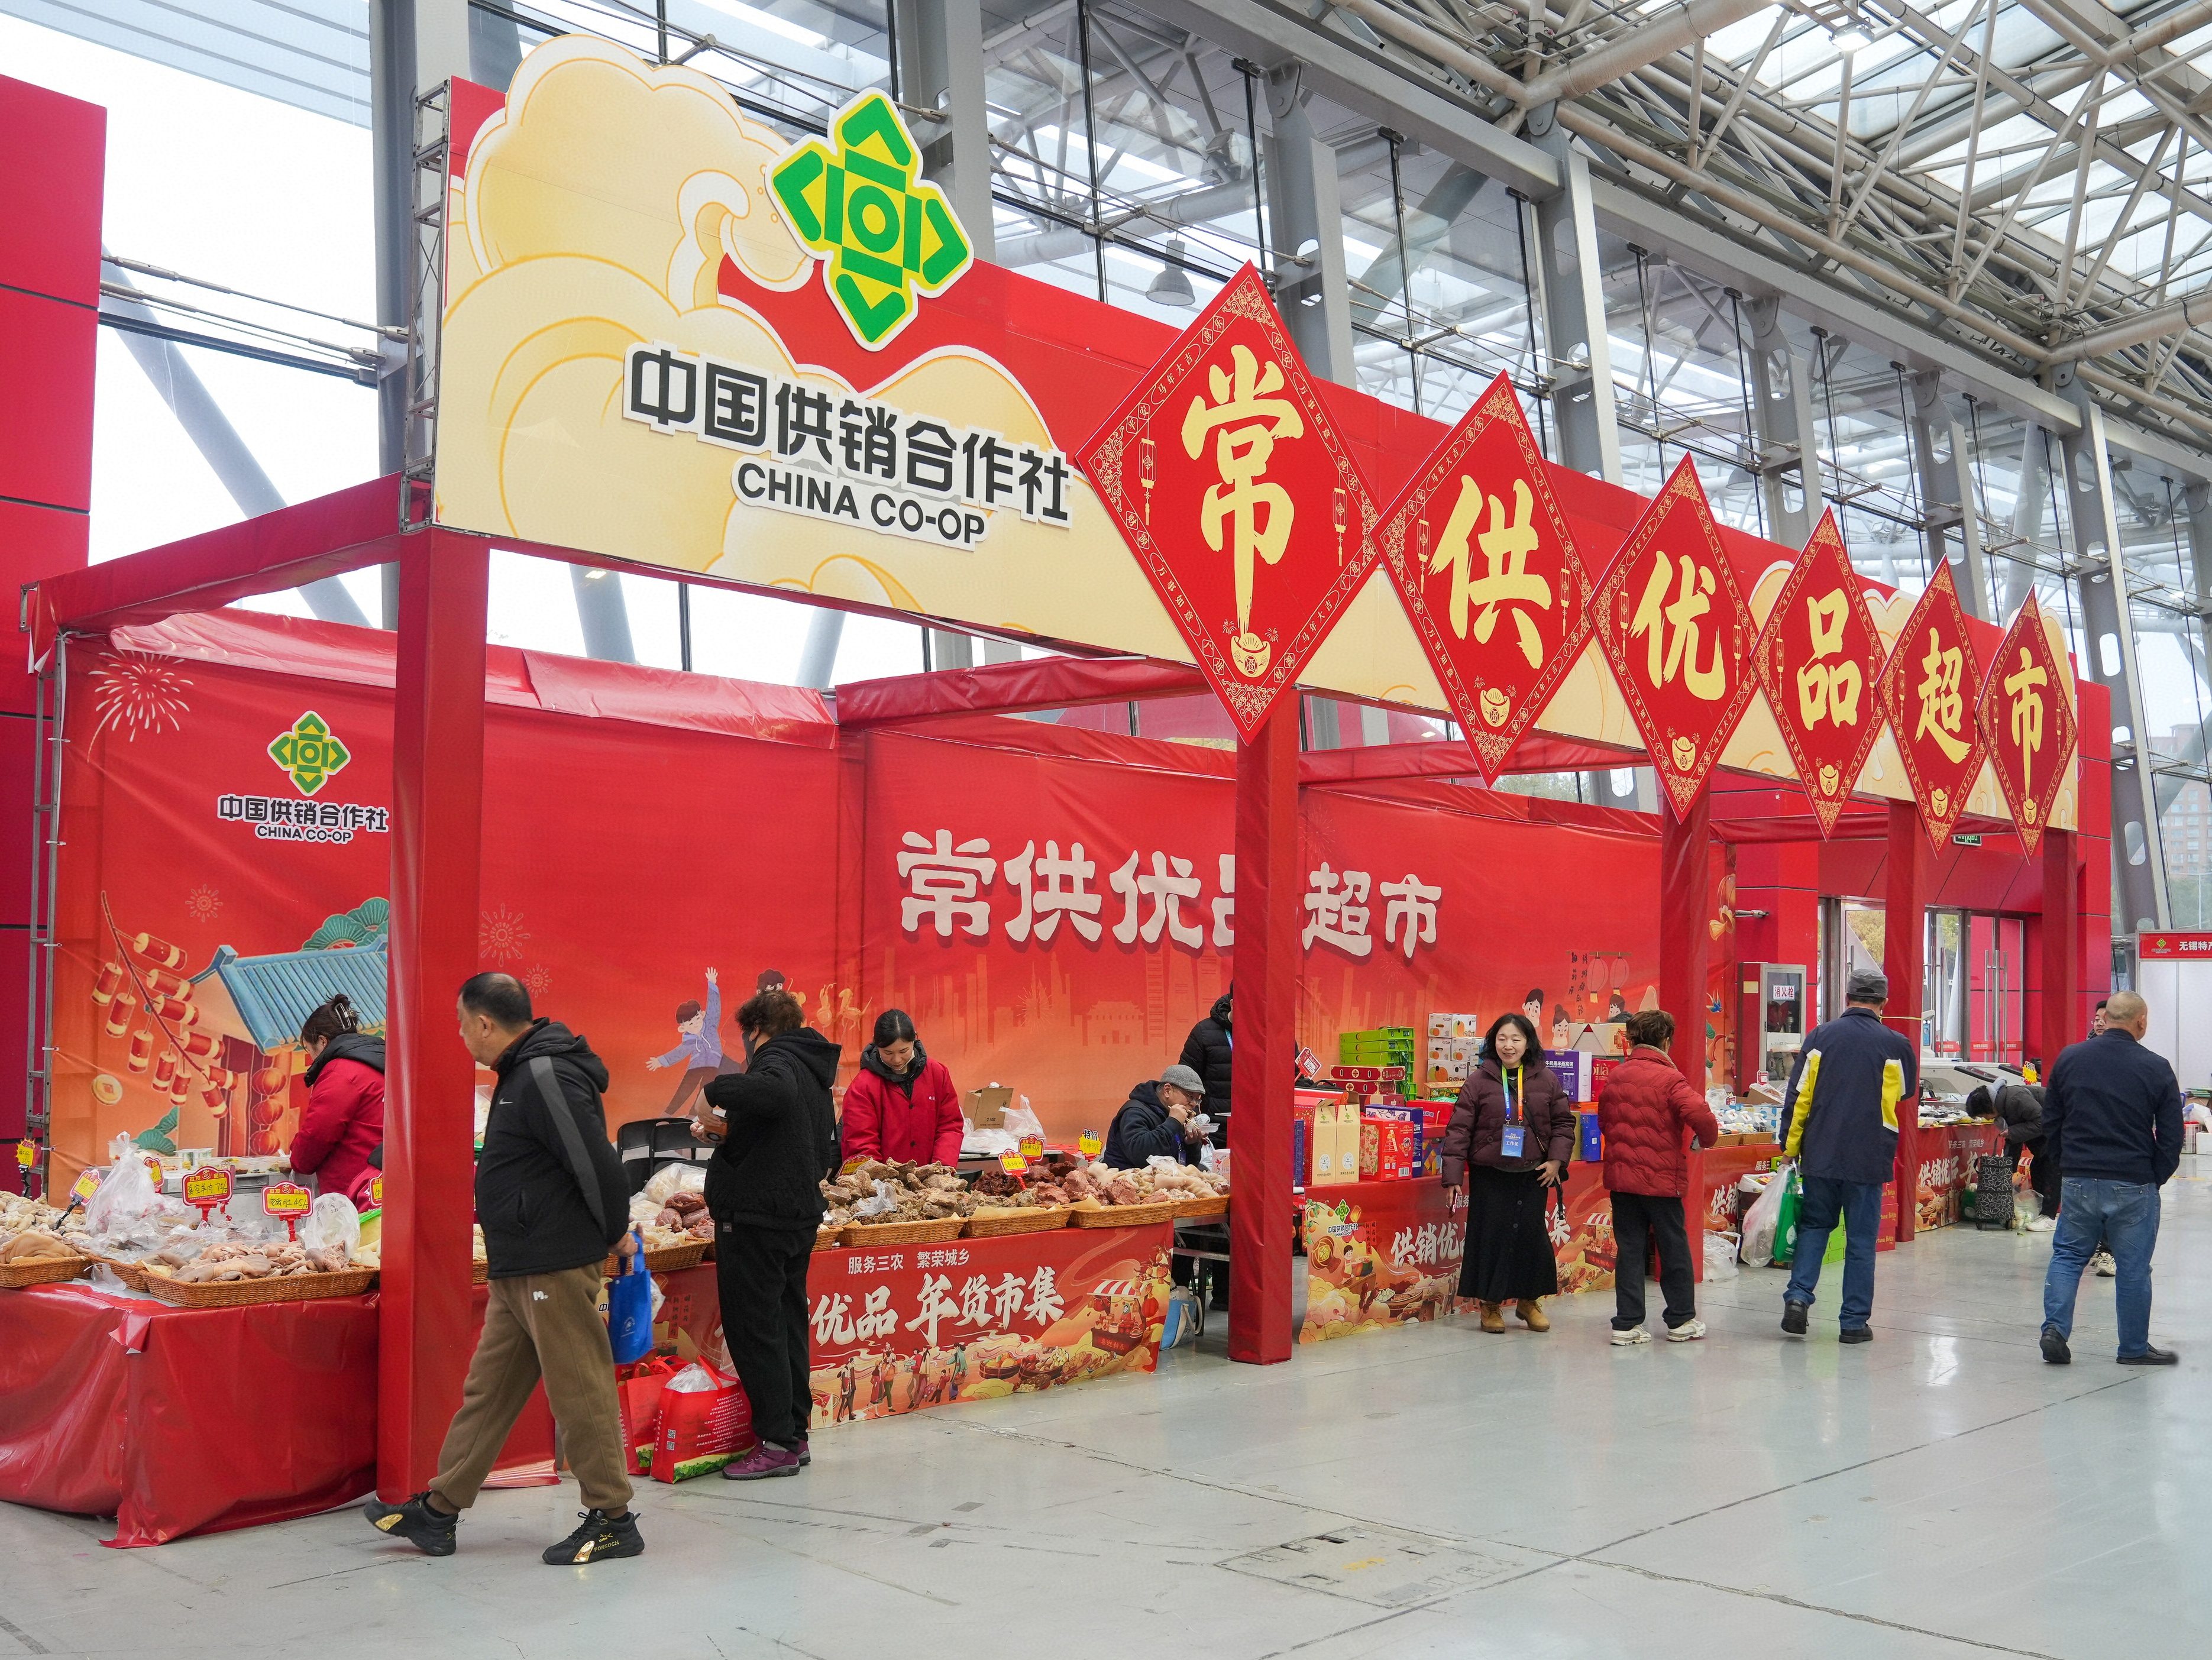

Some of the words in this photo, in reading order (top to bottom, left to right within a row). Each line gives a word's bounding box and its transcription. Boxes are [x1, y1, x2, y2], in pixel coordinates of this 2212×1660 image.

[1126, 403, 1150, 433] 平安
[1158, 352, 1192, 394] 马年大吉
[1202, 316, 1224, 345] 喜乐
[1272, 334, 1292, 367] 平安
[1299, 384, 1330, 439] 万事如意
[1338, 457, 1357, 490] 喜乐
[632, 349, 1069, 522] 中国供销合作社
[1408, 490, 1425, 515] 平安
[1431, 448, 1459, 482] 马年大吉
[1467, 418, 1483, 441] 喜乐
[738, 462, 861, 520] CHINA
[871, 493, 985, 544] CO-OP
[1519, 433, 1534, 463] 平安
[1538, 480, 1560, 526] 万事如意
[1566, 542, 1579, 571] 喜乐
[1126, 512, 1149, 549] 财源
[1157, 564, 1193, 623] 万事如意
[1202, 640, 1224, 675] 广进
[1181, 345, 1304, 635] 常
[1429, 475, 1552, 669] 供
[1631, 551, 1726, 701] 优
[1796, 588, 1862, 731] 品
[1916, 627, 1972, 764] 超
[2004, 648, 2049, 801] 市
[1274, 653, 1294, 682] 财源
[1302, 595, 1332, 648] 马年大吉
[1341, 558, 1357, 589] 广进
[1406, 582, 1423, 613] 财源
[1428, 627, 1453, 678] 万事如意
[1459, 694, 1475, 724] 广进
[1512, 708, 1528, 734] 财源
[1534, 660, 1557, 705] 马年大吉
[1564, 629, 1577, 656] 广进
[219, 795, 387, 831] 中国供销合作社
[257, 825, 302, 840] CHINA
[306, 829, 352, 842] CO-OP
[897, 829, 1442, 958] 常供优超市
[1774, 986, 1794, 998] 消火栓
[1084, 1128, 1098, 1141] 特价
[848, 1253, 904, 1275] 服务三农
[916, 1248, 971, 1269] 繁荣城乡
[1390, 1221, 1467, 1270] 供销优
[808, 1285, 897, 1347] 优品
[904, 1266, 1065, 1347] 年货市集
[594, 1540, 619, 1552] PORSOCH
